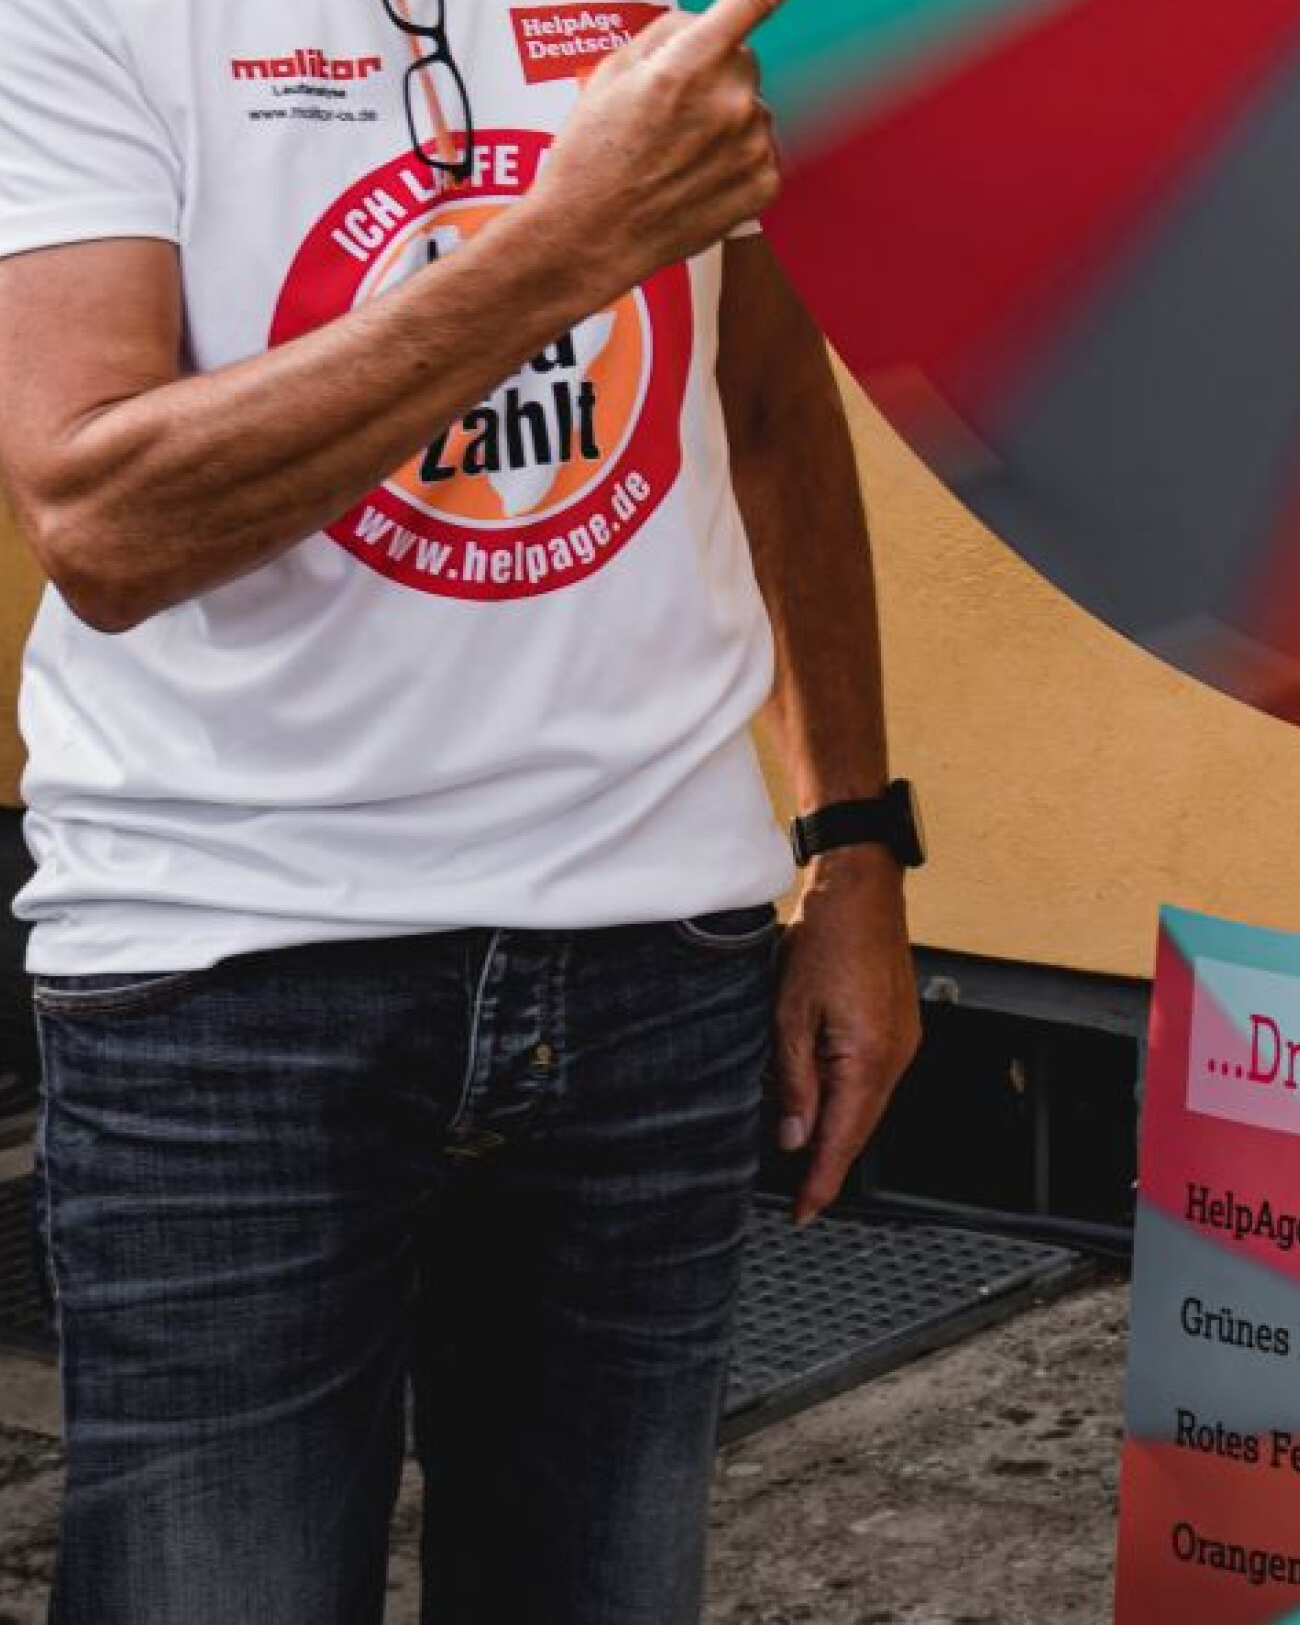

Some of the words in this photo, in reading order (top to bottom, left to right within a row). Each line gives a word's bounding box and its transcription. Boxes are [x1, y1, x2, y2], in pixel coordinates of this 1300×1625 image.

[521, 11, 622, 36] HelpAge
[526, 30, 630, 59] Deutschl
[231, 49, 382, 81] molitor
[331, 188, 408, 262] ICH
[398, 145, 520, 203] LFE
[354, 471, 650, 584] www.helpage.de
[1180, 1296, 1290, 1357] Grünes
[1174, 1407, 1260, 1464] Rotes
